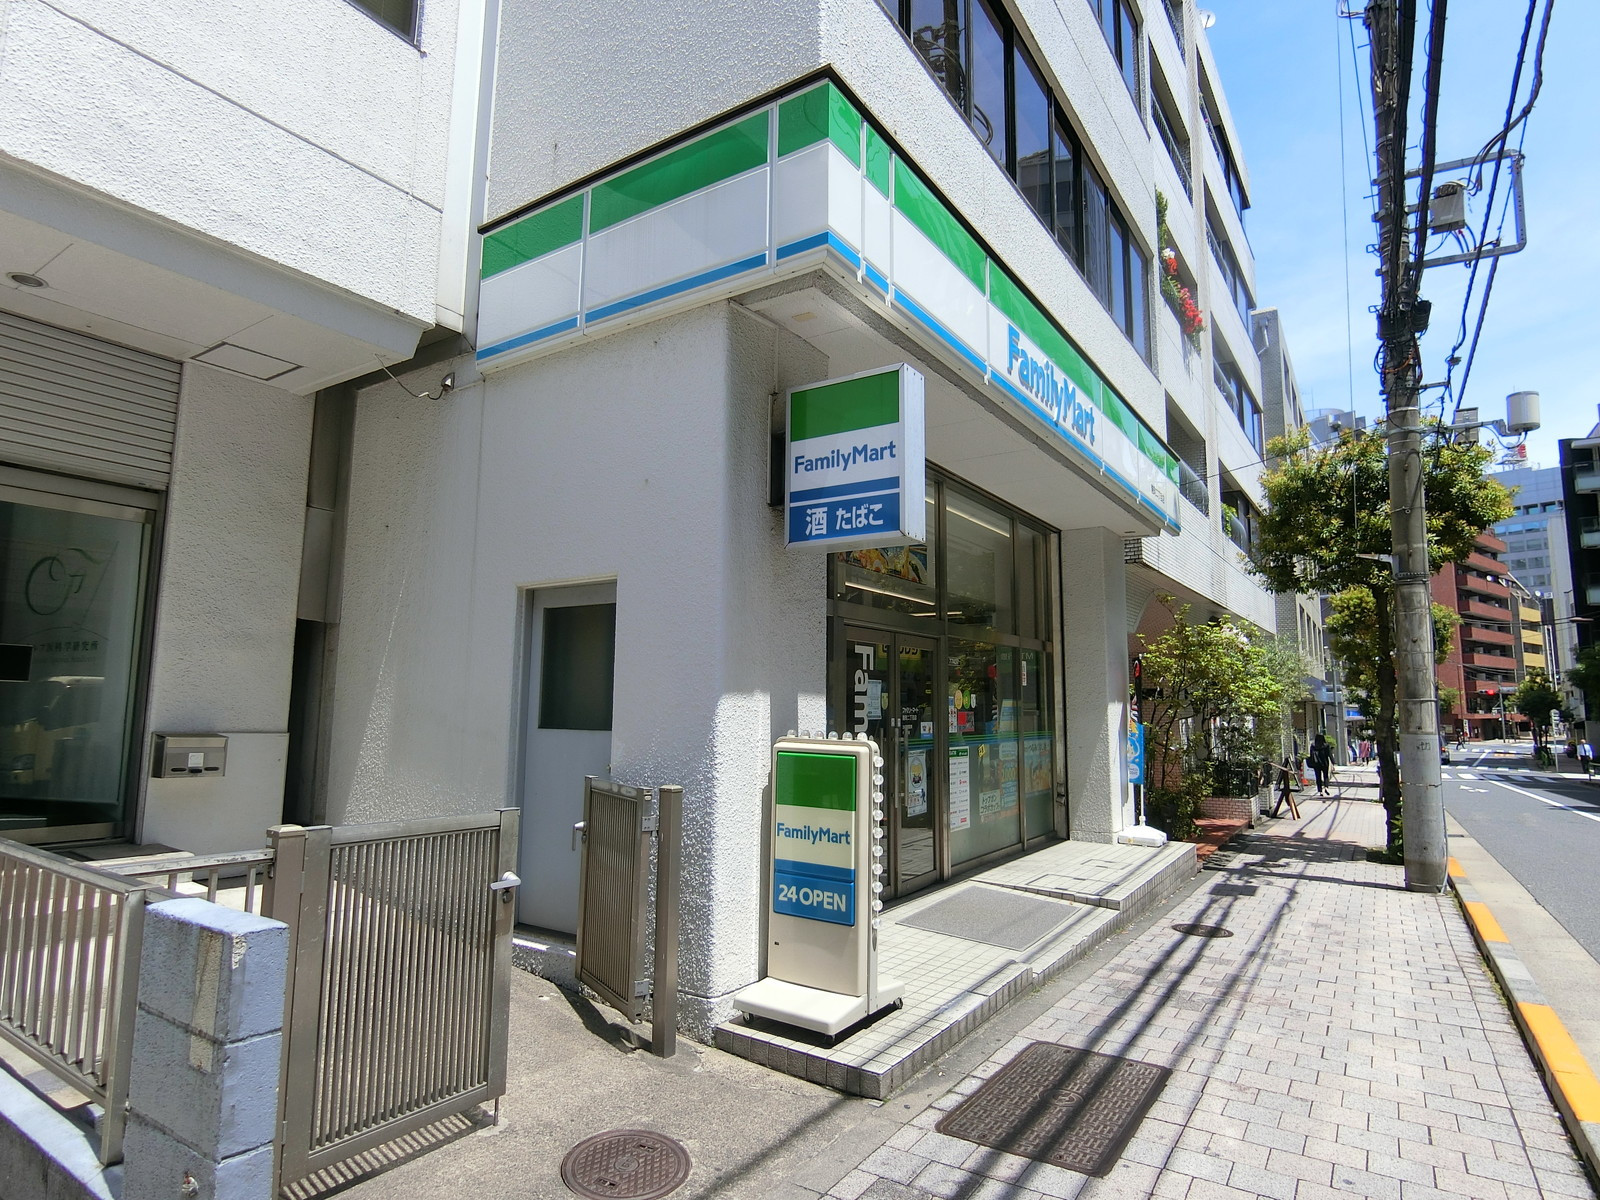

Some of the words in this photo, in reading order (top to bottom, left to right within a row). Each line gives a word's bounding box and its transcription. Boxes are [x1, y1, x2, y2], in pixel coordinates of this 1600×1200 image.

[1007, 321, 1095, 446] FamilyMart
[794, 440, 896, 474] FamilyMart
[805, 506, 828, 536] 酒
[835, 503, 884, 530] たばこ
[776, 822, 851, 845] FamilyMart
